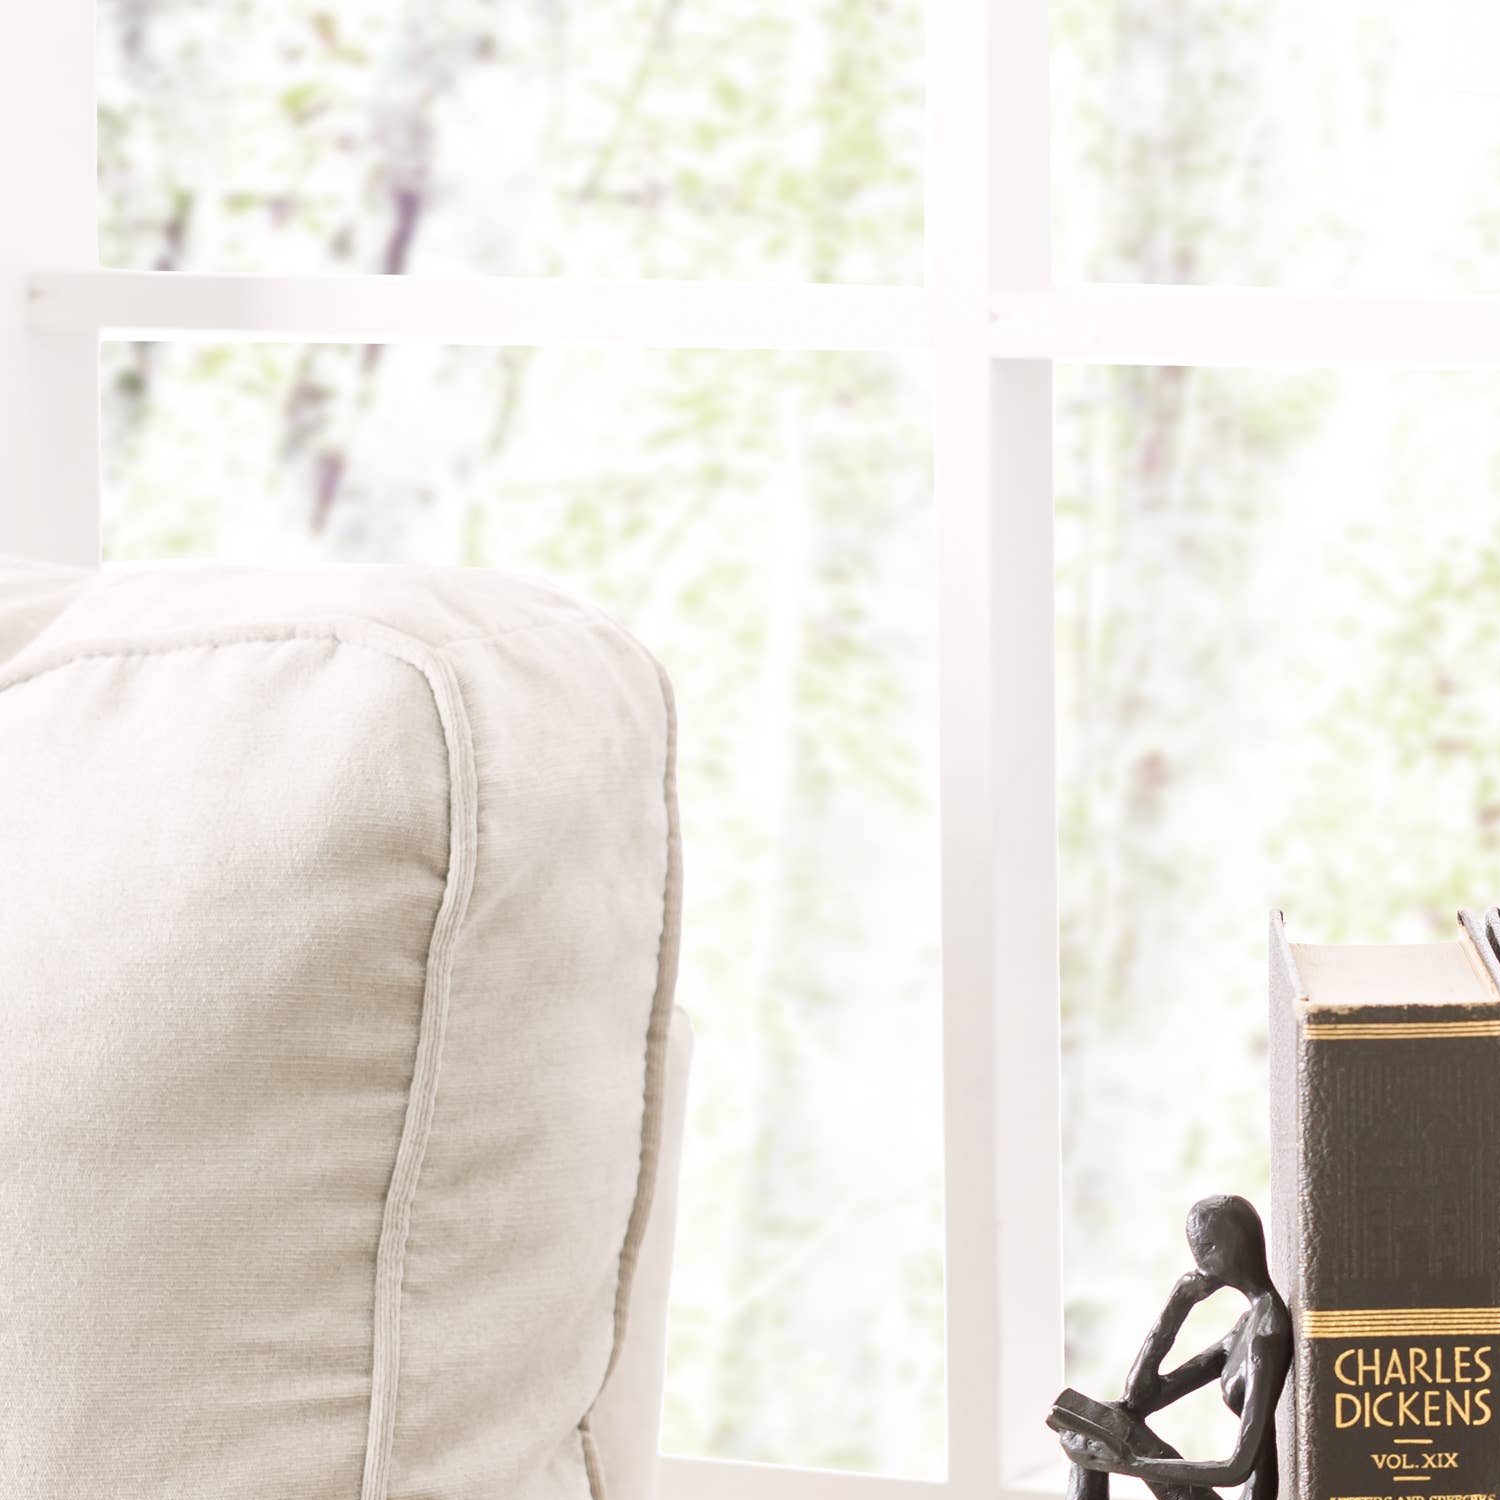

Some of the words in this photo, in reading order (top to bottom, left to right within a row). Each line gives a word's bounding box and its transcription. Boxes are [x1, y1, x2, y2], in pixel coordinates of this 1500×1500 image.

[1334, 1346, 1492, 1386] CHARLES
[1335, 1389, 1492, 1429] DICKENS
[1370, 1454, 1420, 1469] VOL.
[1421, 1453, 1459, 1468] XIX
